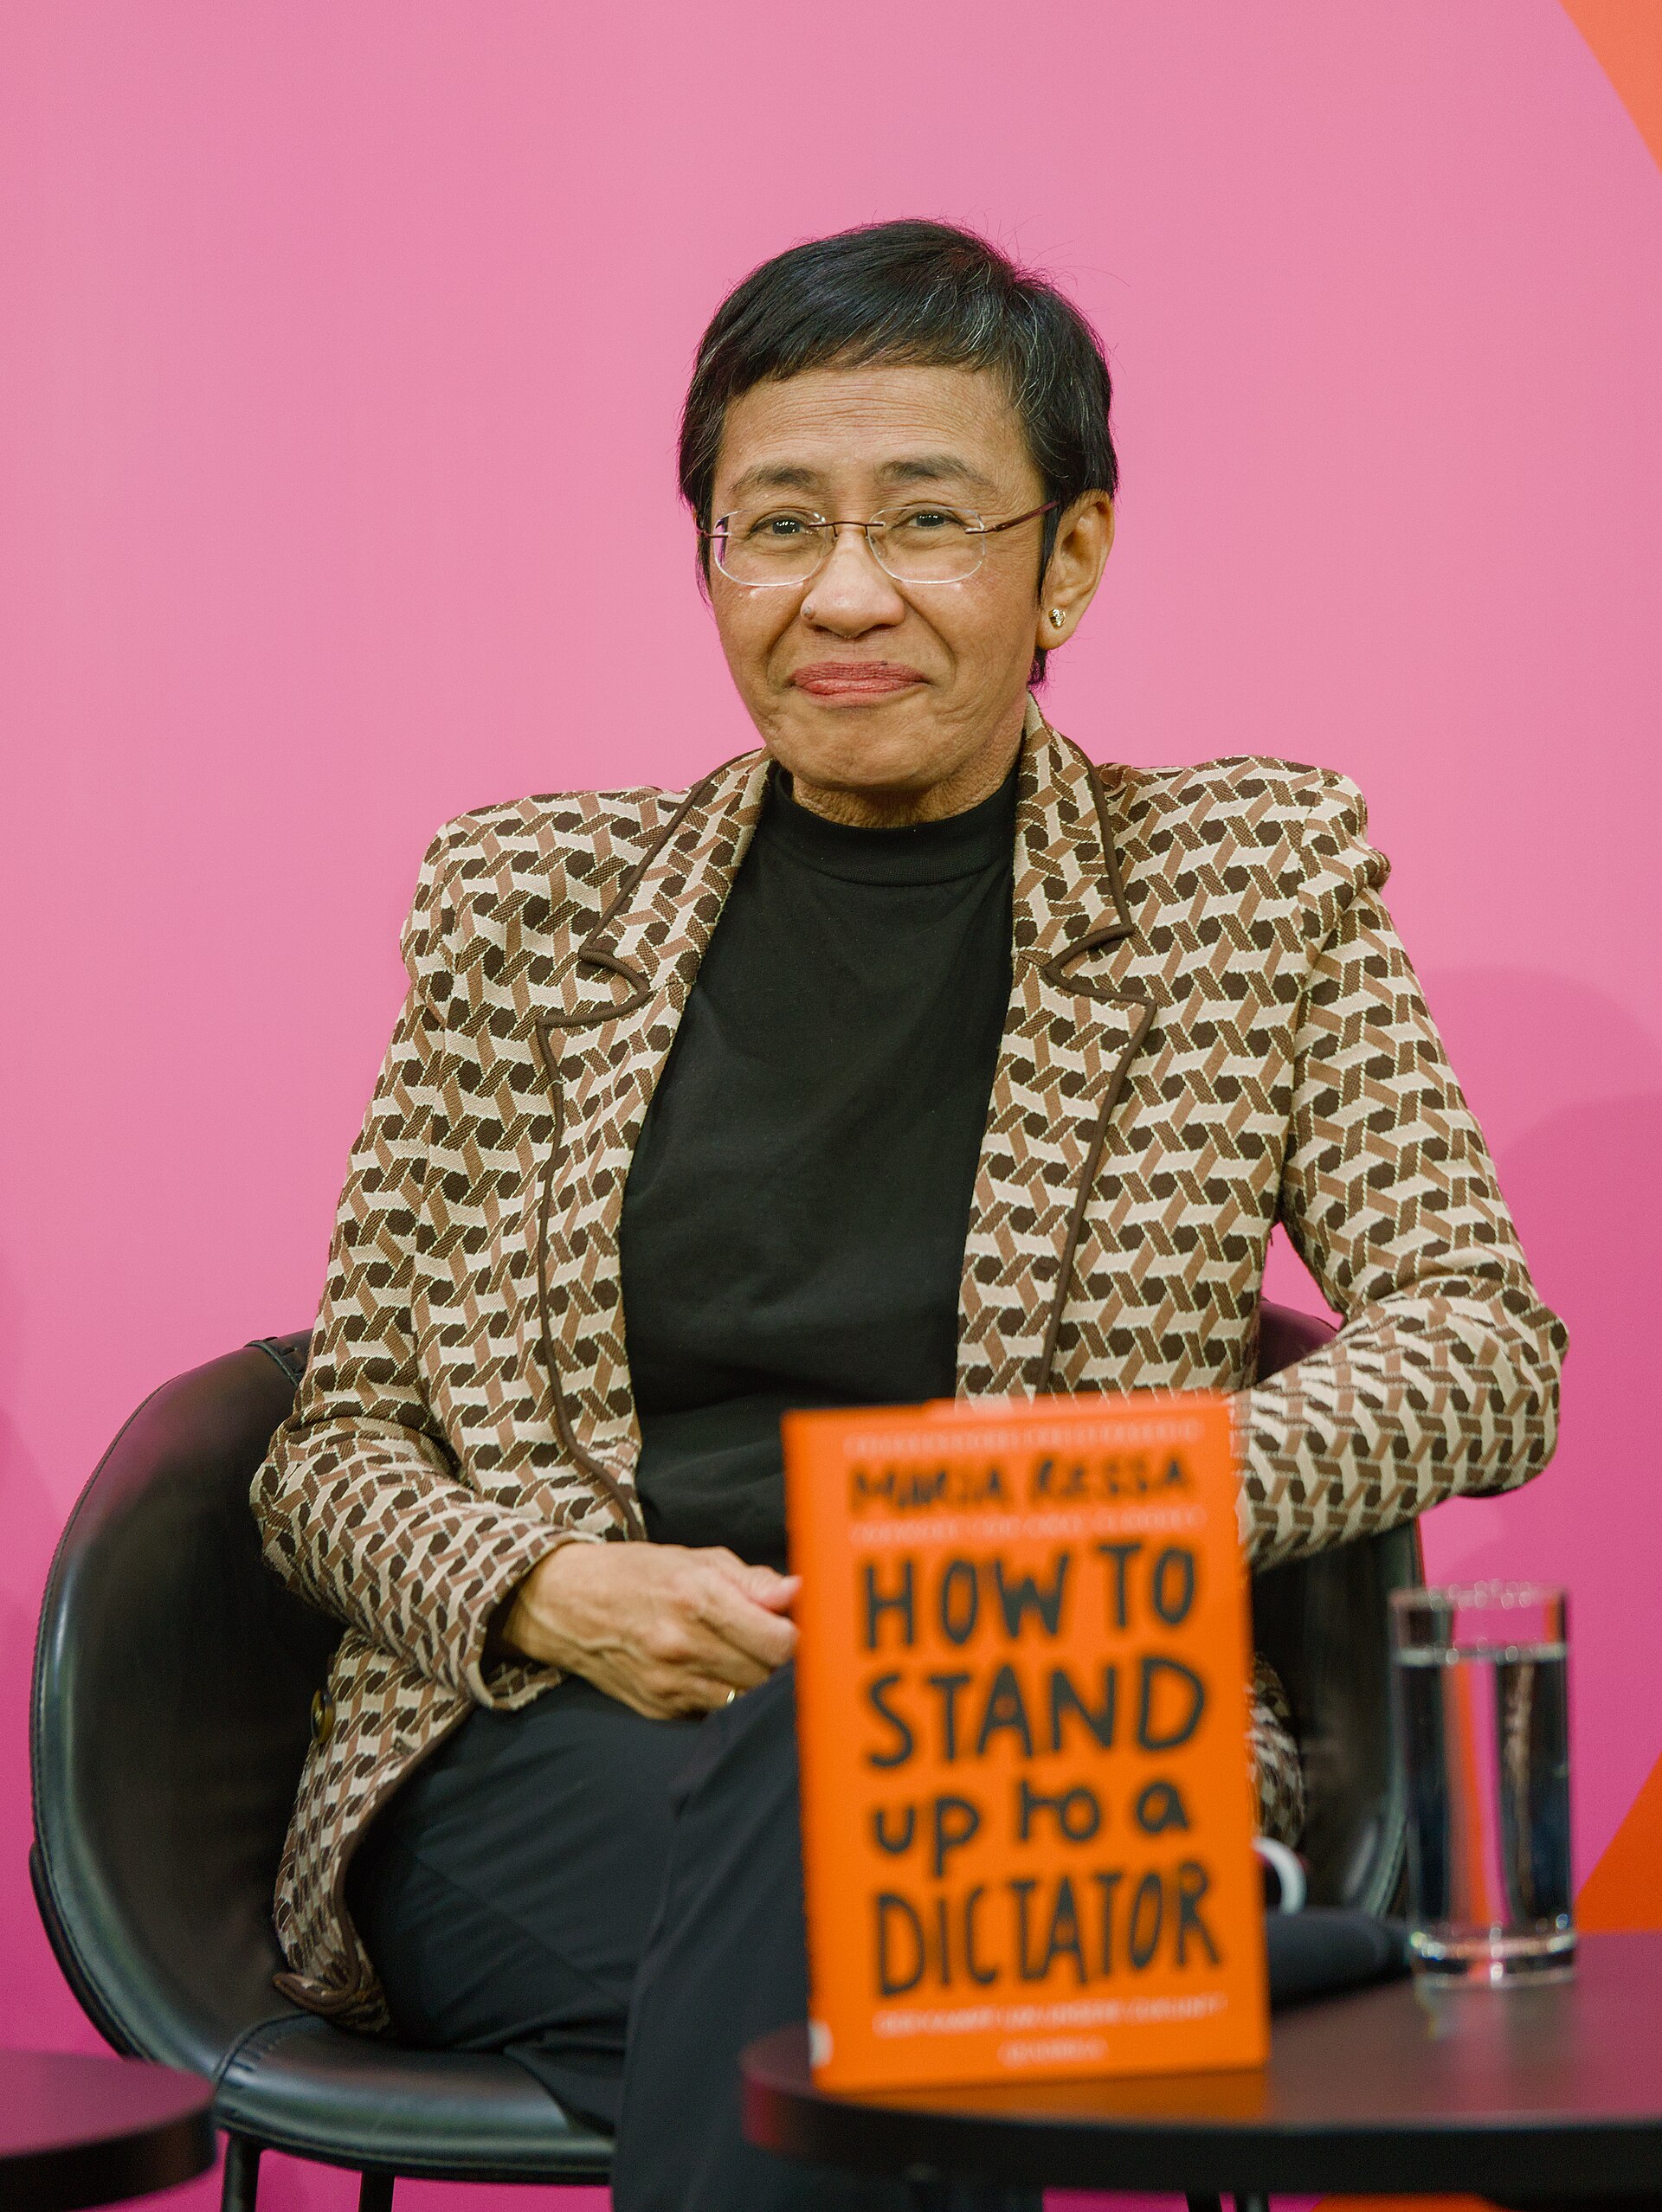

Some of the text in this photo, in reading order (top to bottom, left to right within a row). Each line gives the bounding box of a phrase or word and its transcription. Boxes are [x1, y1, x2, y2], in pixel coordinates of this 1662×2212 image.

[864, 1540, 1197, 1649] HOW TO
[866, 1656, 1207, 1769] STAND
[873, 1791, 981, 1878] up
[1134, 1779, 1189, 1835] a
[876, 1861, 1222, 1997] DICTATOR
